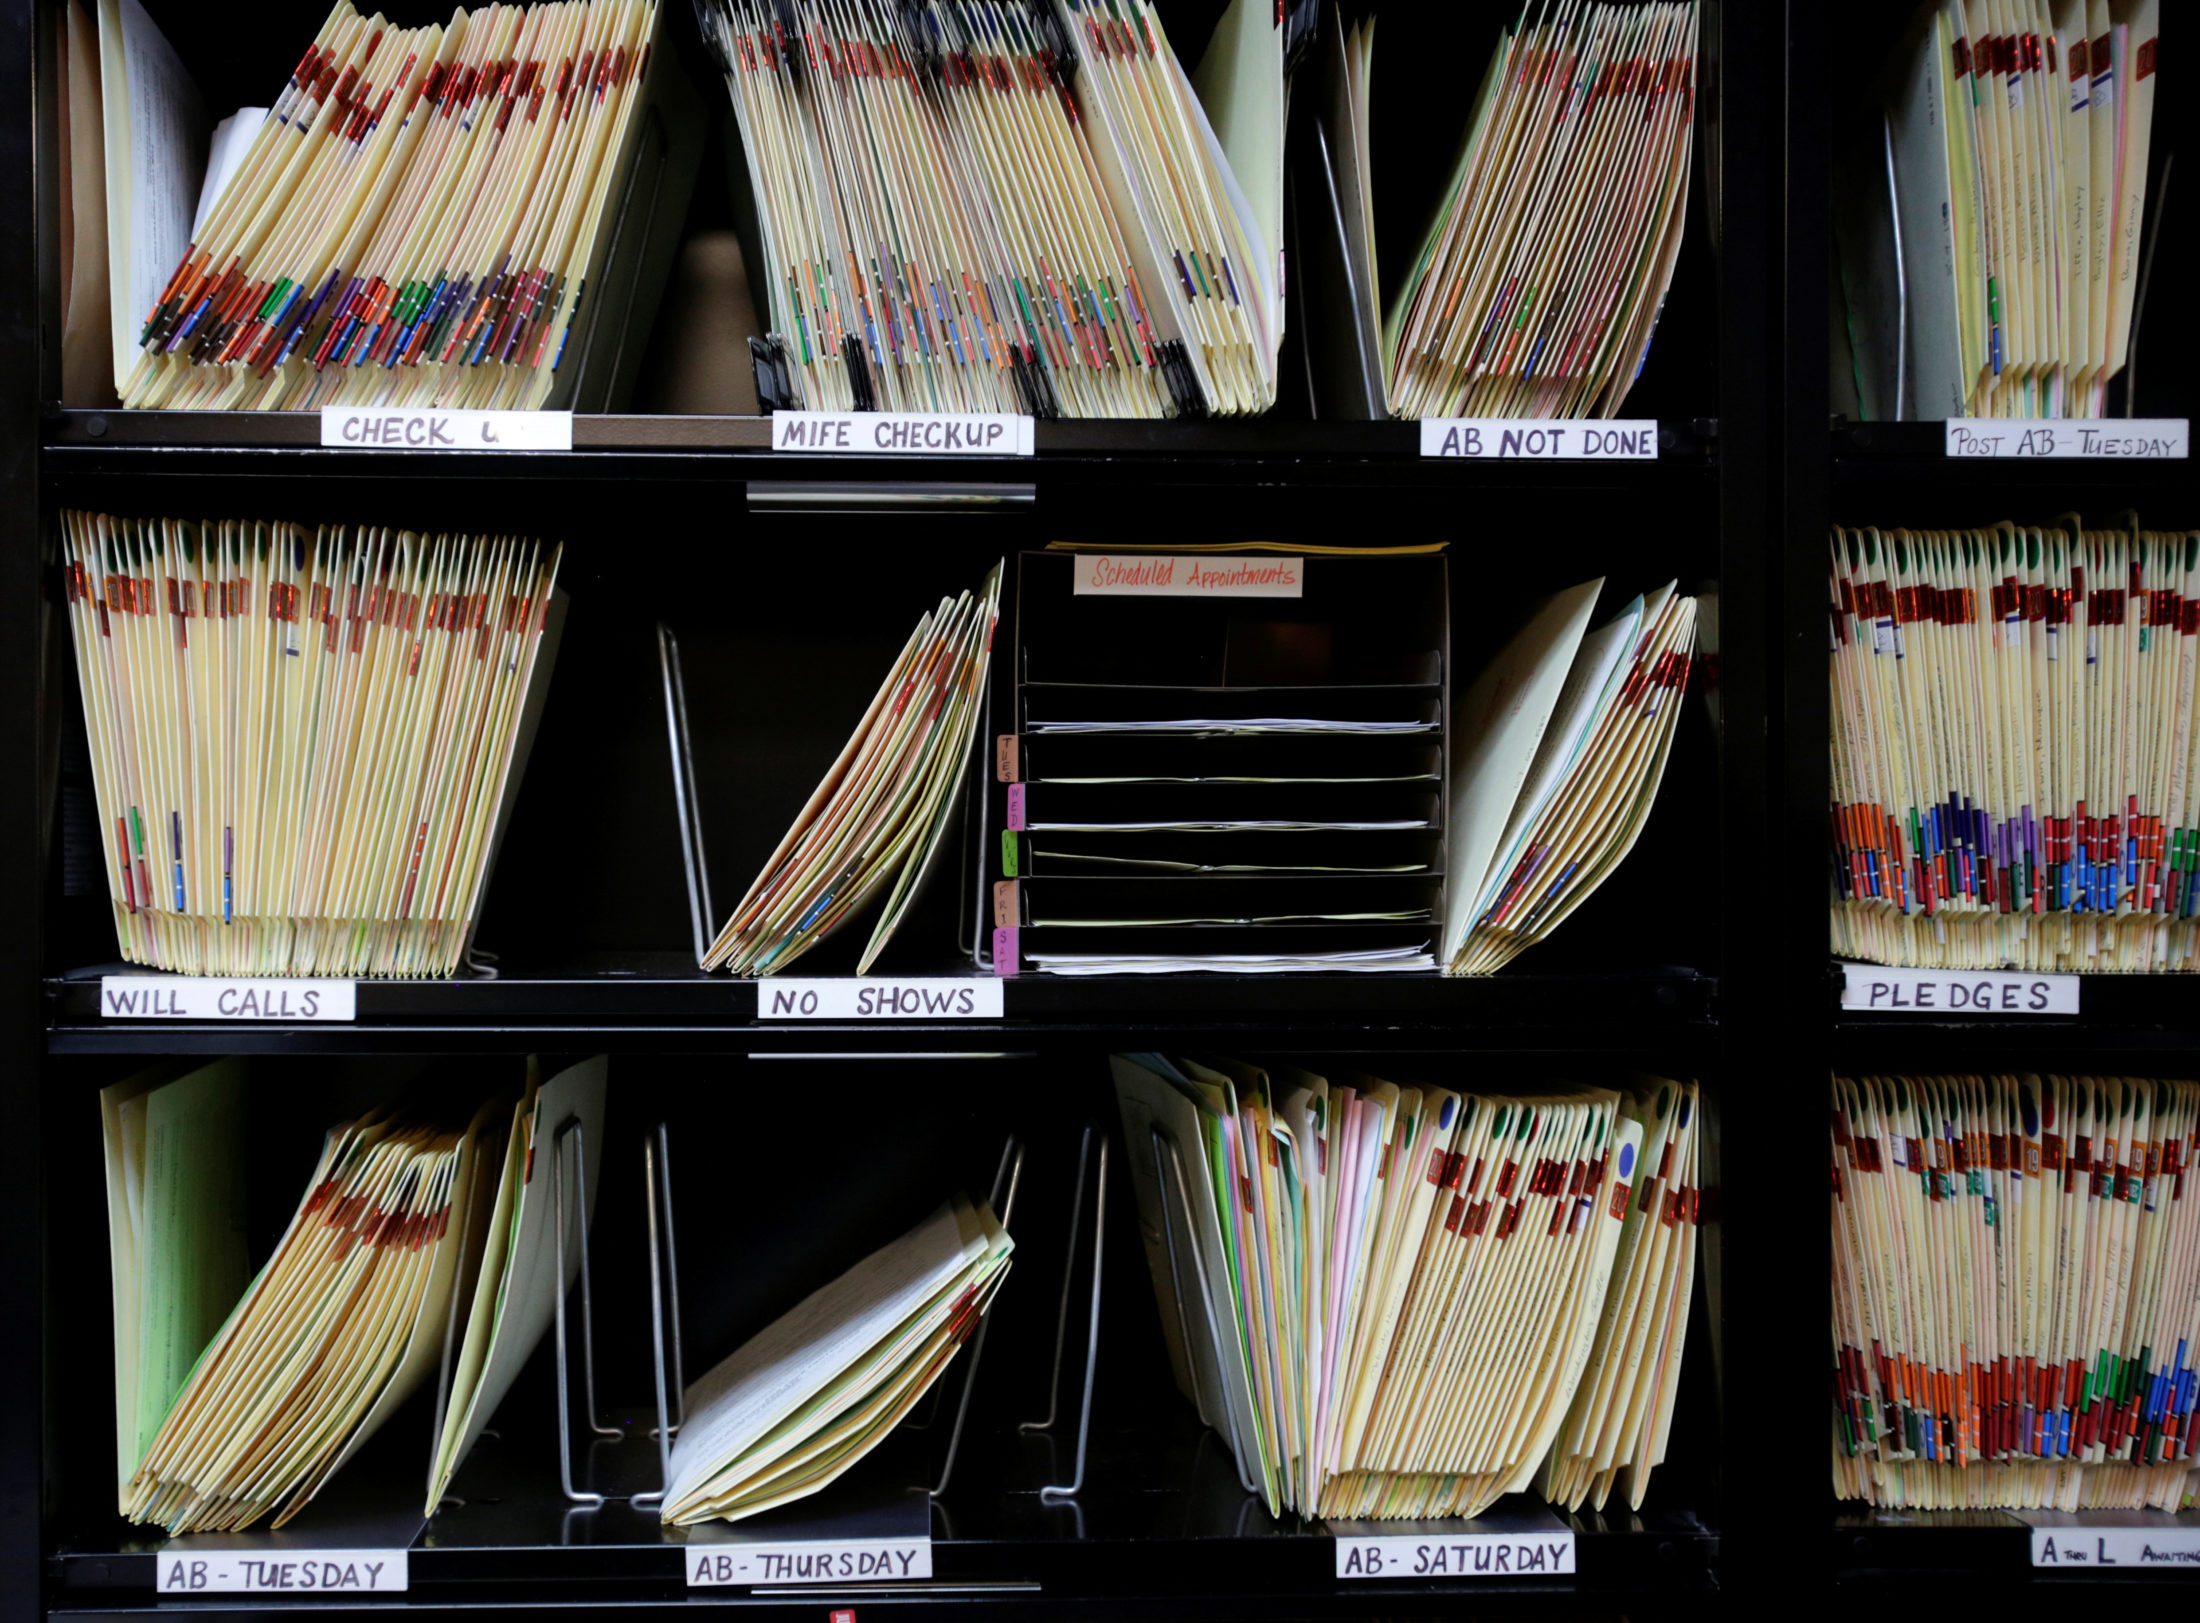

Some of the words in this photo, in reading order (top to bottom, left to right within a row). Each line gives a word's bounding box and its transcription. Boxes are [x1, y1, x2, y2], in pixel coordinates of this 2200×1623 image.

[342, 416, 455, 446] CHECK
[781, 420, 852, 447] MIFE
[874, 420, 1004, 450] CHECKUP
[1440, 426, 1483, 456] AB
[1499, 428, 1565, 458] NOT
[1581, 429, 1654, 455] DONE
[1092, 557, 1175, 588] Scheduled
[1186, 561, 1297, 590] Appointments
[106, 989, 187, 1015] WILL
[217, 988, 320, 1018] CALLS
[771, 990, 818, 1015] NO
[856, 986, 975, 1015] SHOWS
[1863, 981, 2051, 1010] PLEDGES
[756, 1550, 916, 1579] THURSDAY
[1414, 1543, 1568, 1574] SATURDAY
[2041, 1536, 2058, 1562] A
[2098, 1538, 2116, 1563] L
[239, 1560, 384, 1589] TUESDAY
